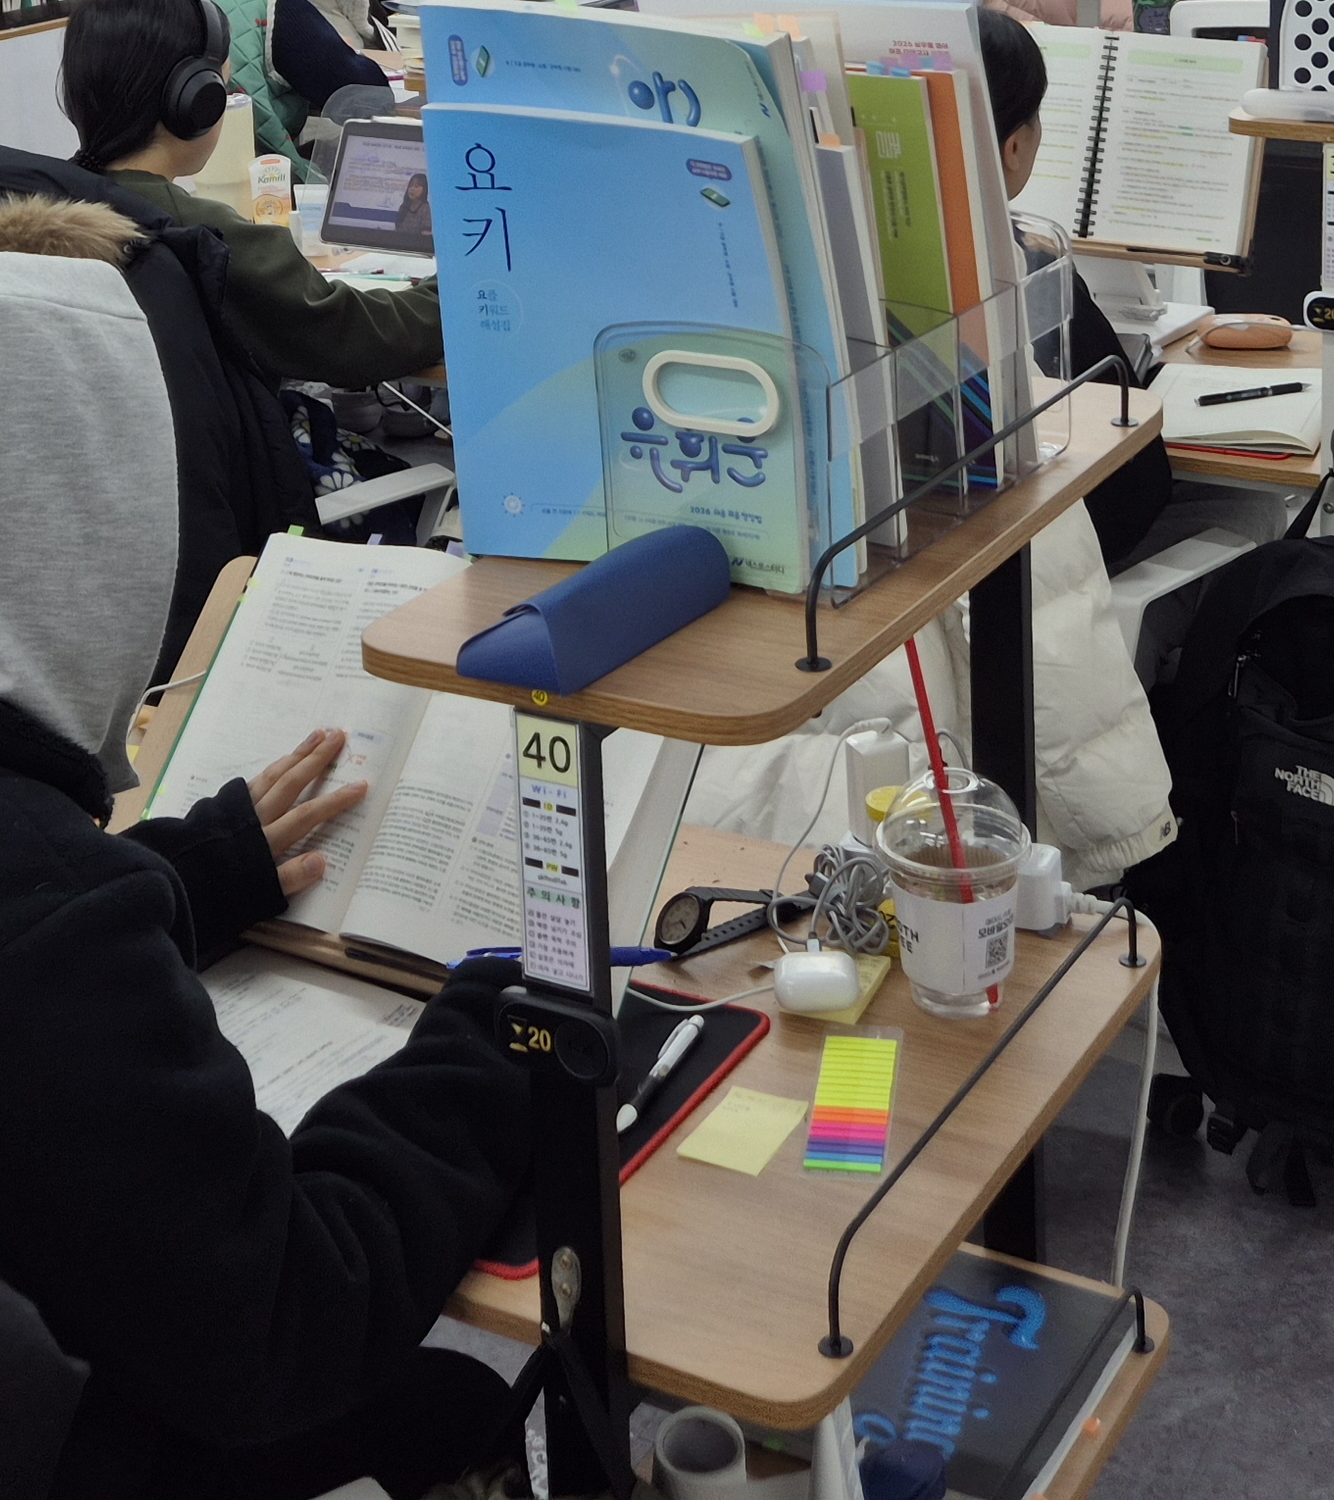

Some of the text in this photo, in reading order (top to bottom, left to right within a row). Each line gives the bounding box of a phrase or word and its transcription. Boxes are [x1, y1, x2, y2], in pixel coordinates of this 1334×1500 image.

[533, 691, 545, 702] 40
[523, 731, 571, 773] 40
[1274, 767, 1321, 790] NORTH
[1295, 764, 1321, 780] THE
[532, 784, 567, 799] Wi-Fi
[1286, 780, 1320, 801] FACE
[528, 1026, 552, 1052] 20
